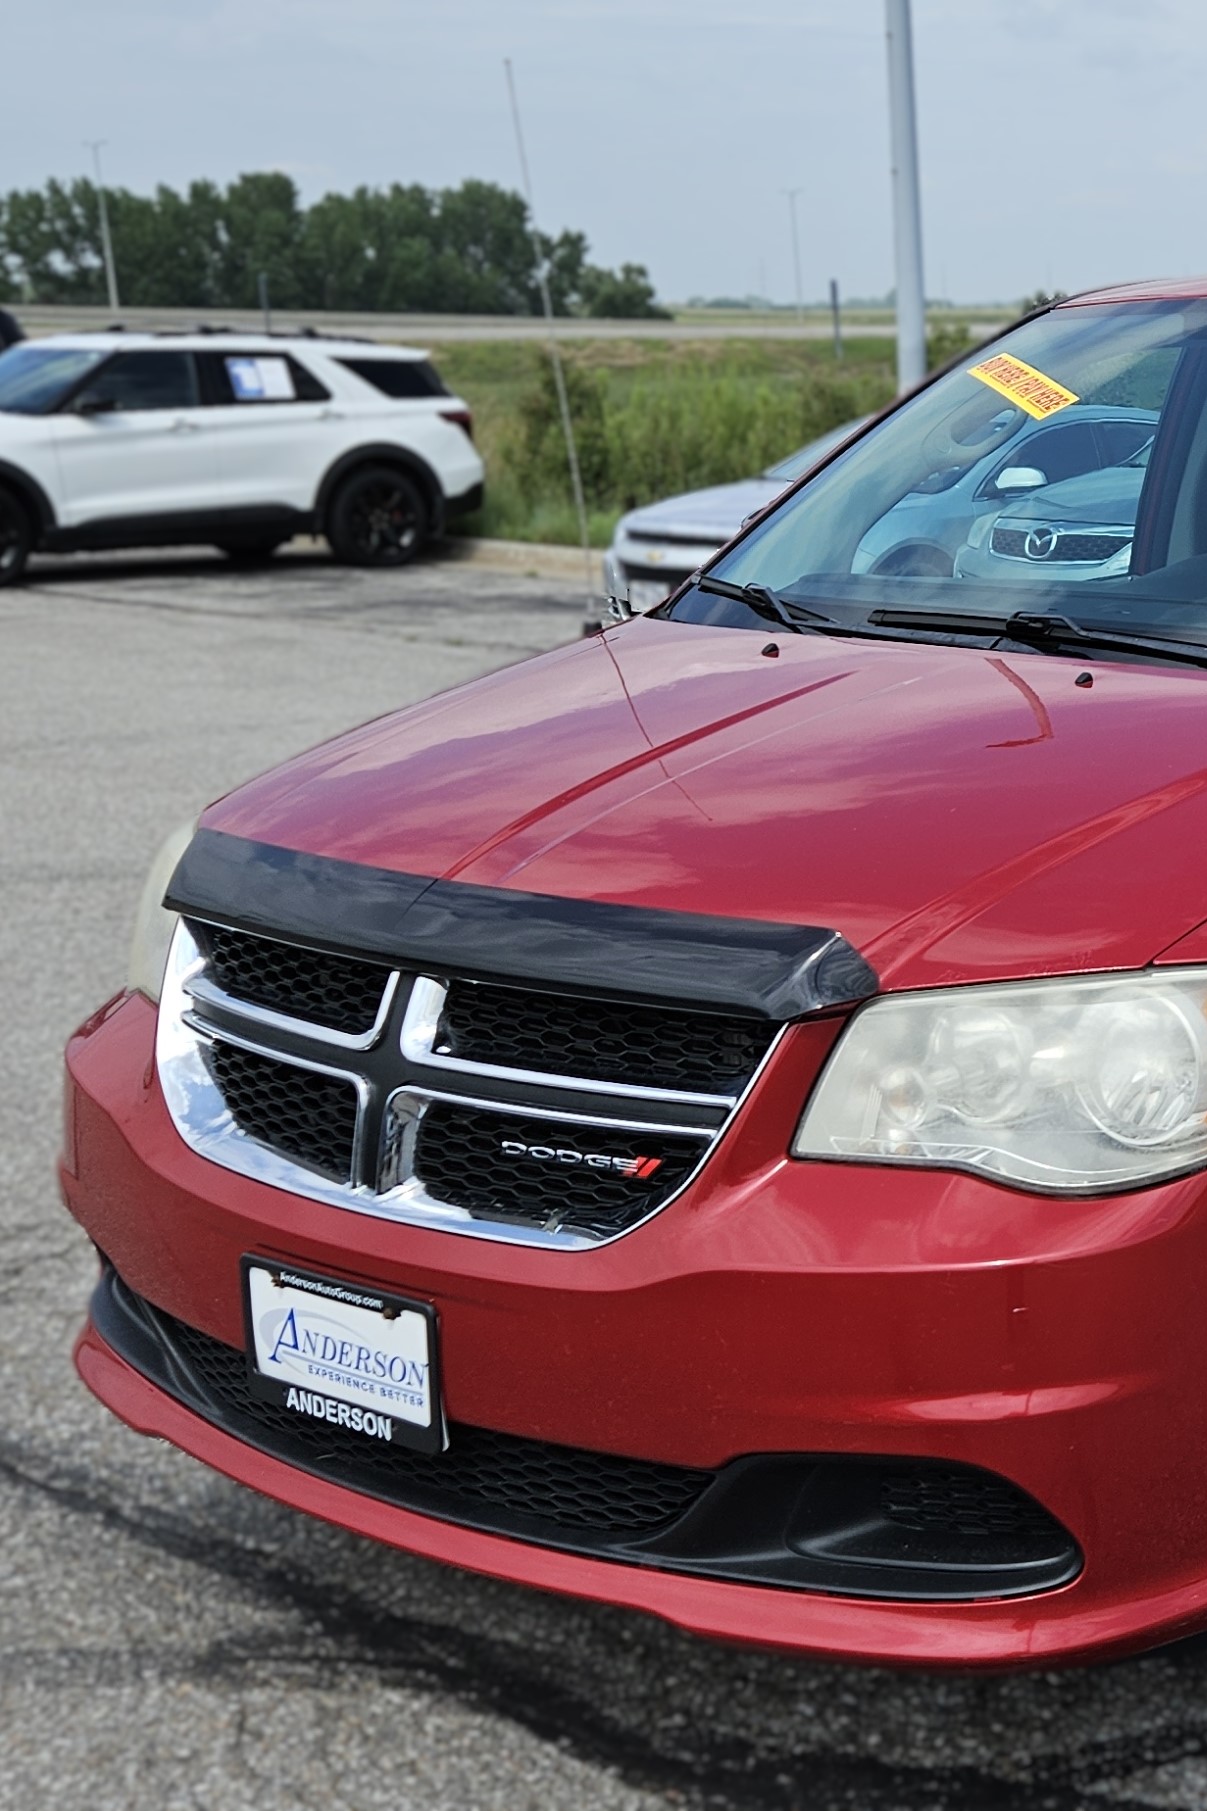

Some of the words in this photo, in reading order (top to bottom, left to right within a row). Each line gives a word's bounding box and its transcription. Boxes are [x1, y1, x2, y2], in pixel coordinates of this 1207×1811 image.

[1026, 387, 1071, 414] HERE
[502, 1140, 639, 1173] DODGE
[280, 1271, 384, 1309] AndersonAutoGroup.com
[308, 1365, 376, 1394] EXPERIENCE
[379, 1387, 425, 1408] BETTER
[286, 1387, 392, 1441] ANDERSON
